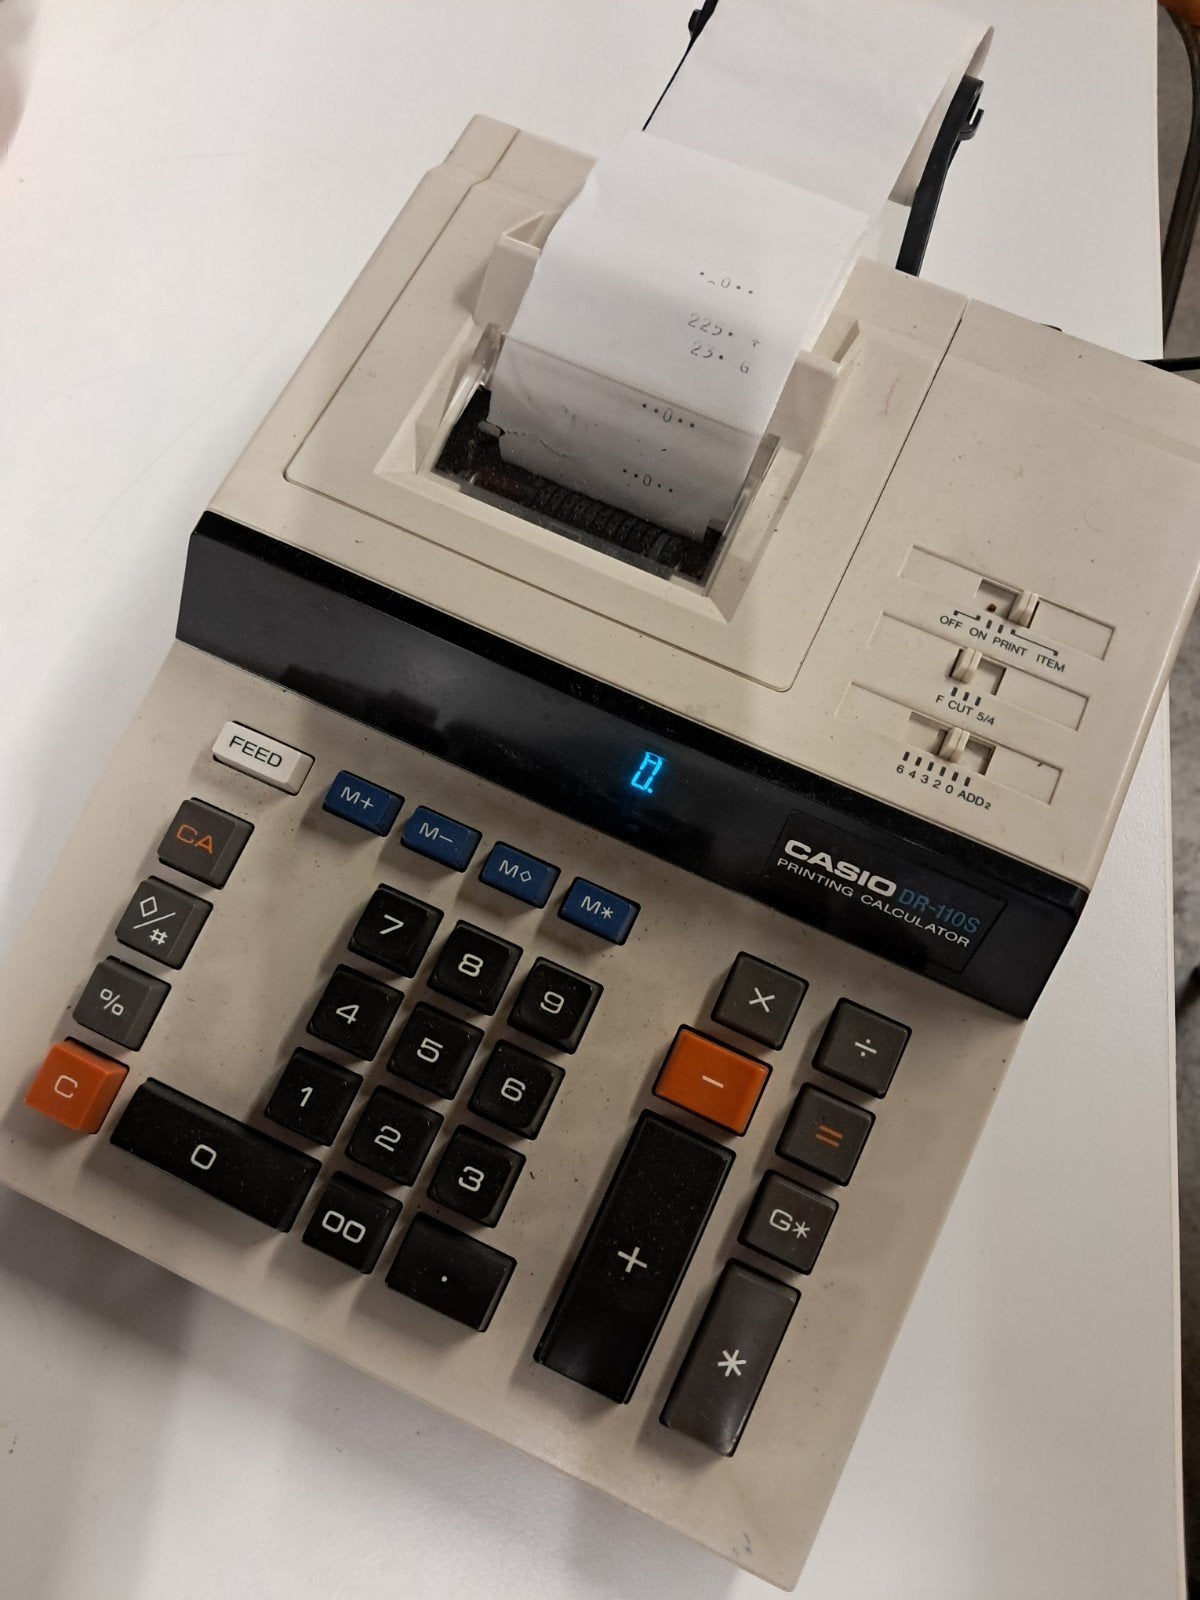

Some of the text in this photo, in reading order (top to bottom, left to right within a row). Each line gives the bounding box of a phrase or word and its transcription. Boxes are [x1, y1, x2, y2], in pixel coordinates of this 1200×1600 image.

[939, 615, 1066, 673] OFF ON PRINT ITEM
[936, 695, 995, 726] F CUT 5/4
[229, 736, 283, 769] FEED
[896, 765, 904, 774] 6
[908, 770, 916, 779] 4
[920, 774, 928, 784] 3
[932, 779, 941, 789] 2
[176, 823, 214, 854] CA
[784, 839, 981, 934] CASIO DR-110S
[776, 857, 971, 949] PRINTING CALCULATOR
[378, 913, 404, 935] 7
[457, 953, 484, 978] 8
[100, 988, 124, 1017] %
[335, 1004, 360, 1025] 4
[540, 990, 565, 1015] 9
[416, 1037, 444, 1063] 5
[53, 1074, 78, 1100] C
[299, 1086, 313, 1107] 1
[500, 1077, 526, 1102] 6
[374, 1125, 401, 1153] 2
[457, 1165, 485, 1192] 3
